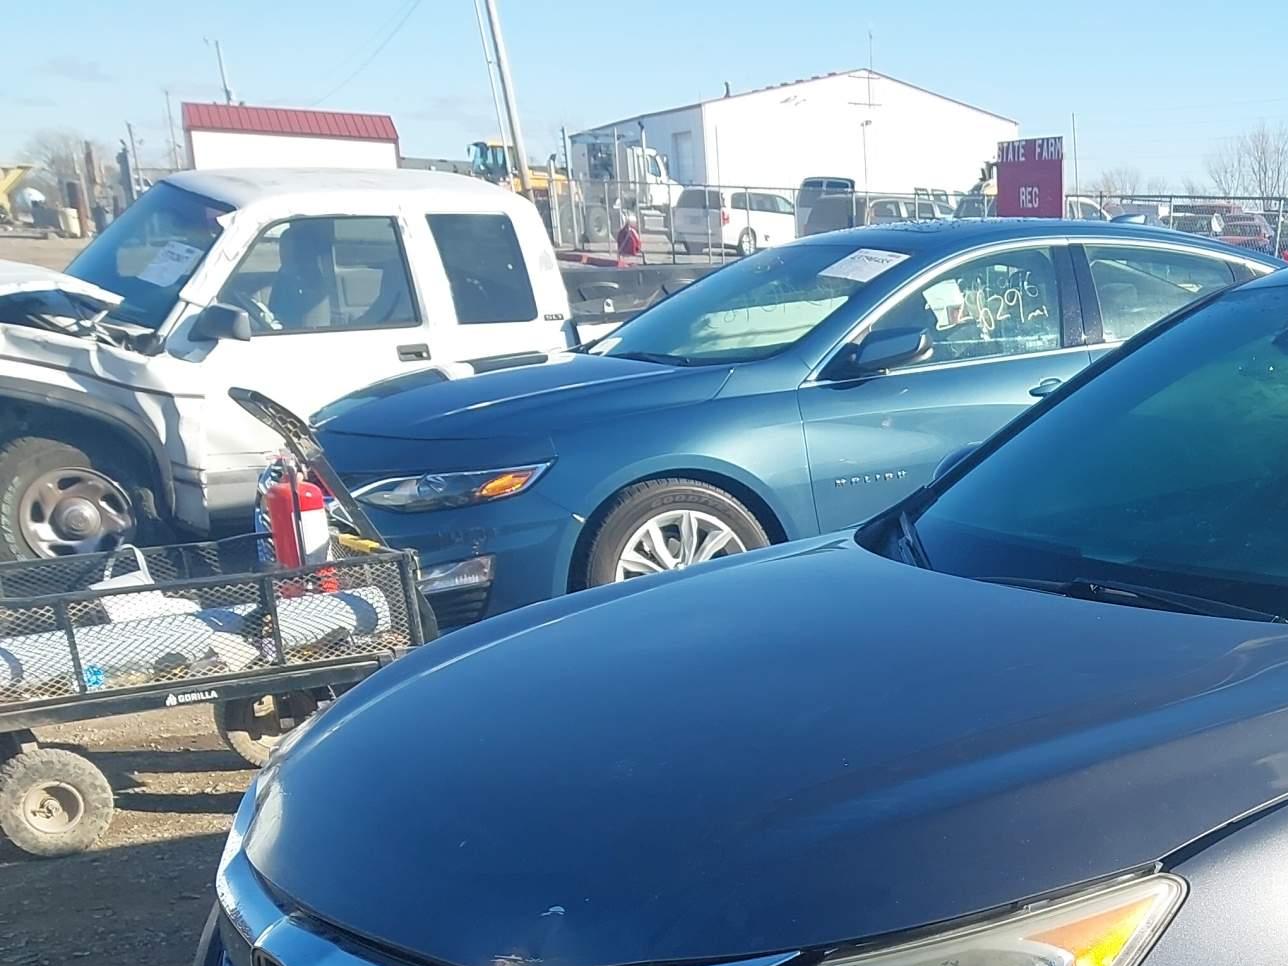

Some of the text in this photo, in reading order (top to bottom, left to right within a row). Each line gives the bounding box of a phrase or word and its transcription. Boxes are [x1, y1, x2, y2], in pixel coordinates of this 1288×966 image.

[998, 138, 1062, 162] STATE FARM
[177, 690, 218, 703] GORILLA
